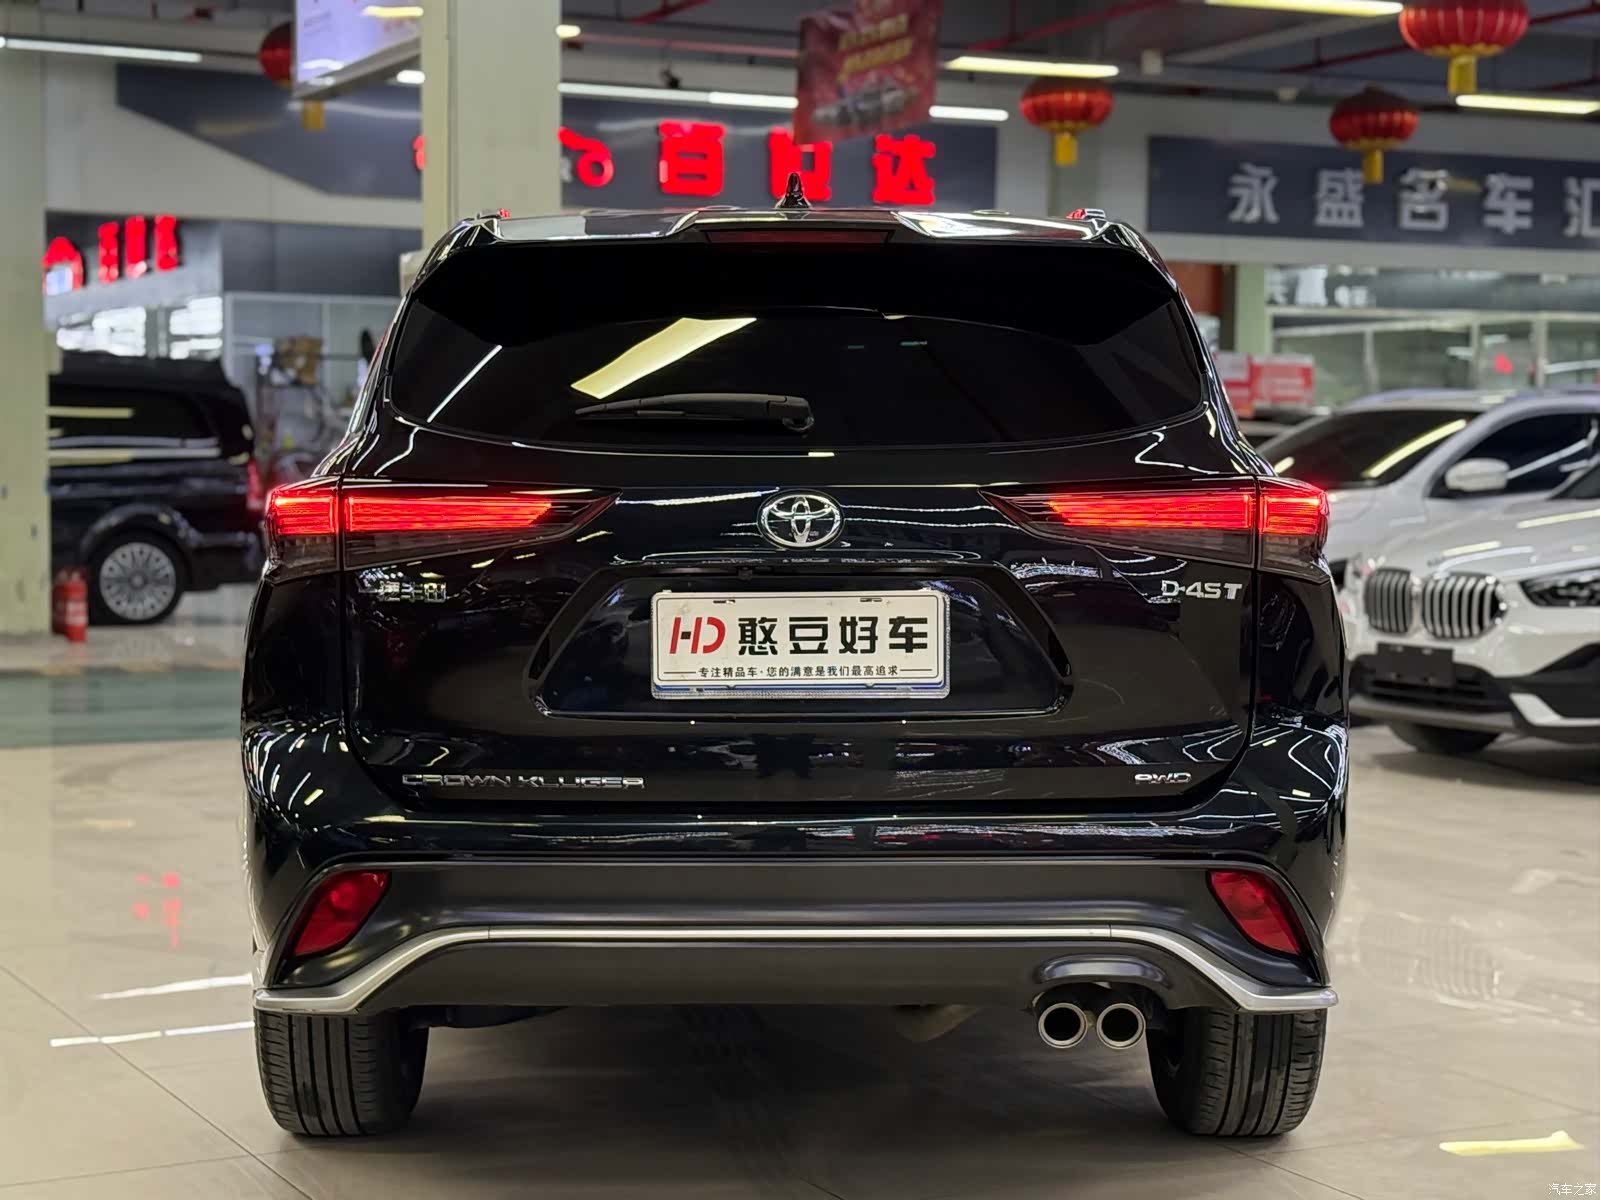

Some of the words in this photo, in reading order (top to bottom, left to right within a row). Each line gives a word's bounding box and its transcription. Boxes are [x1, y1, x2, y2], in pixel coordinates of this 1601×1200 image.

[1228, 163, 1600, 238] 永盛名车汇
[669, 616, 726, 654] HD
[738, 616, 928, 655] 憨豆好车
[402, 774, 511, 787] CROWN
[518, 775, 645, 789] KLUGER
